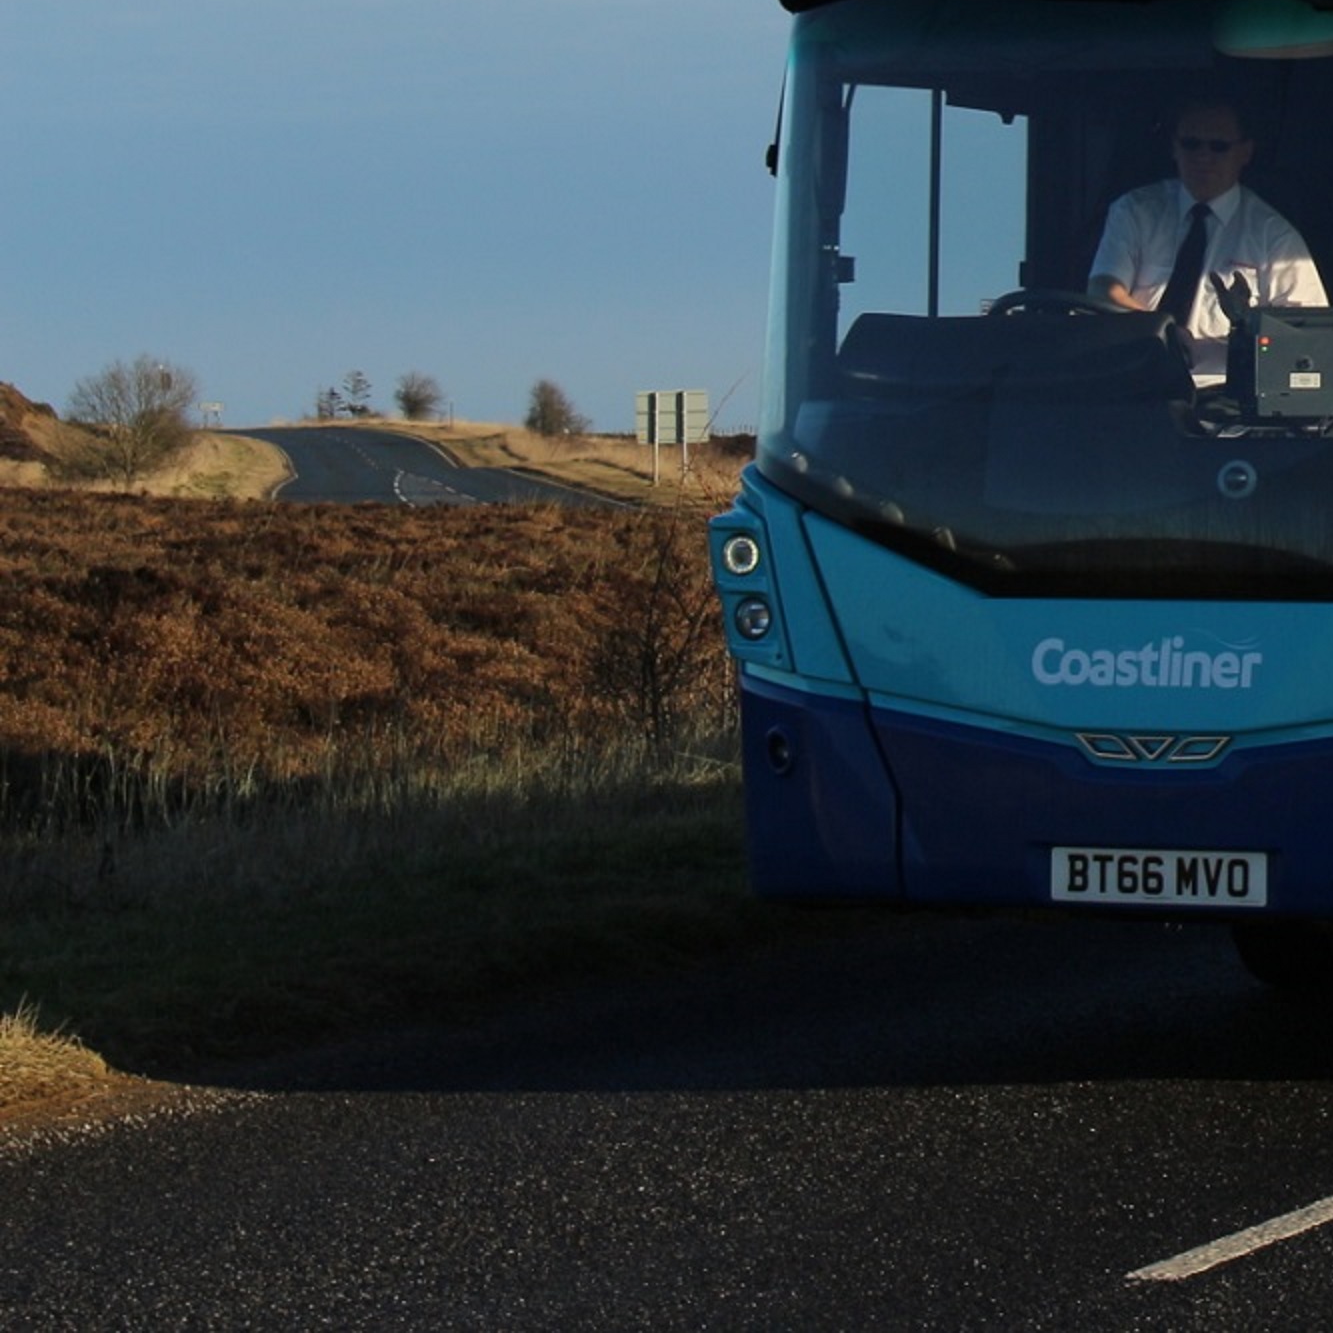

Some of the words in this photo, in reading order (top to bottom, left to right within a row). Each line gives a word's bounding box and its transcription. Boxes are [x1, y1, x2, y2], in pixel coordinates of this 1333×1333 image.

[1031, 635, 1263, 689] Coastliner
[1067, 853, 1164, 896] BT66
[1175, 856, 1249, 898] MVO
